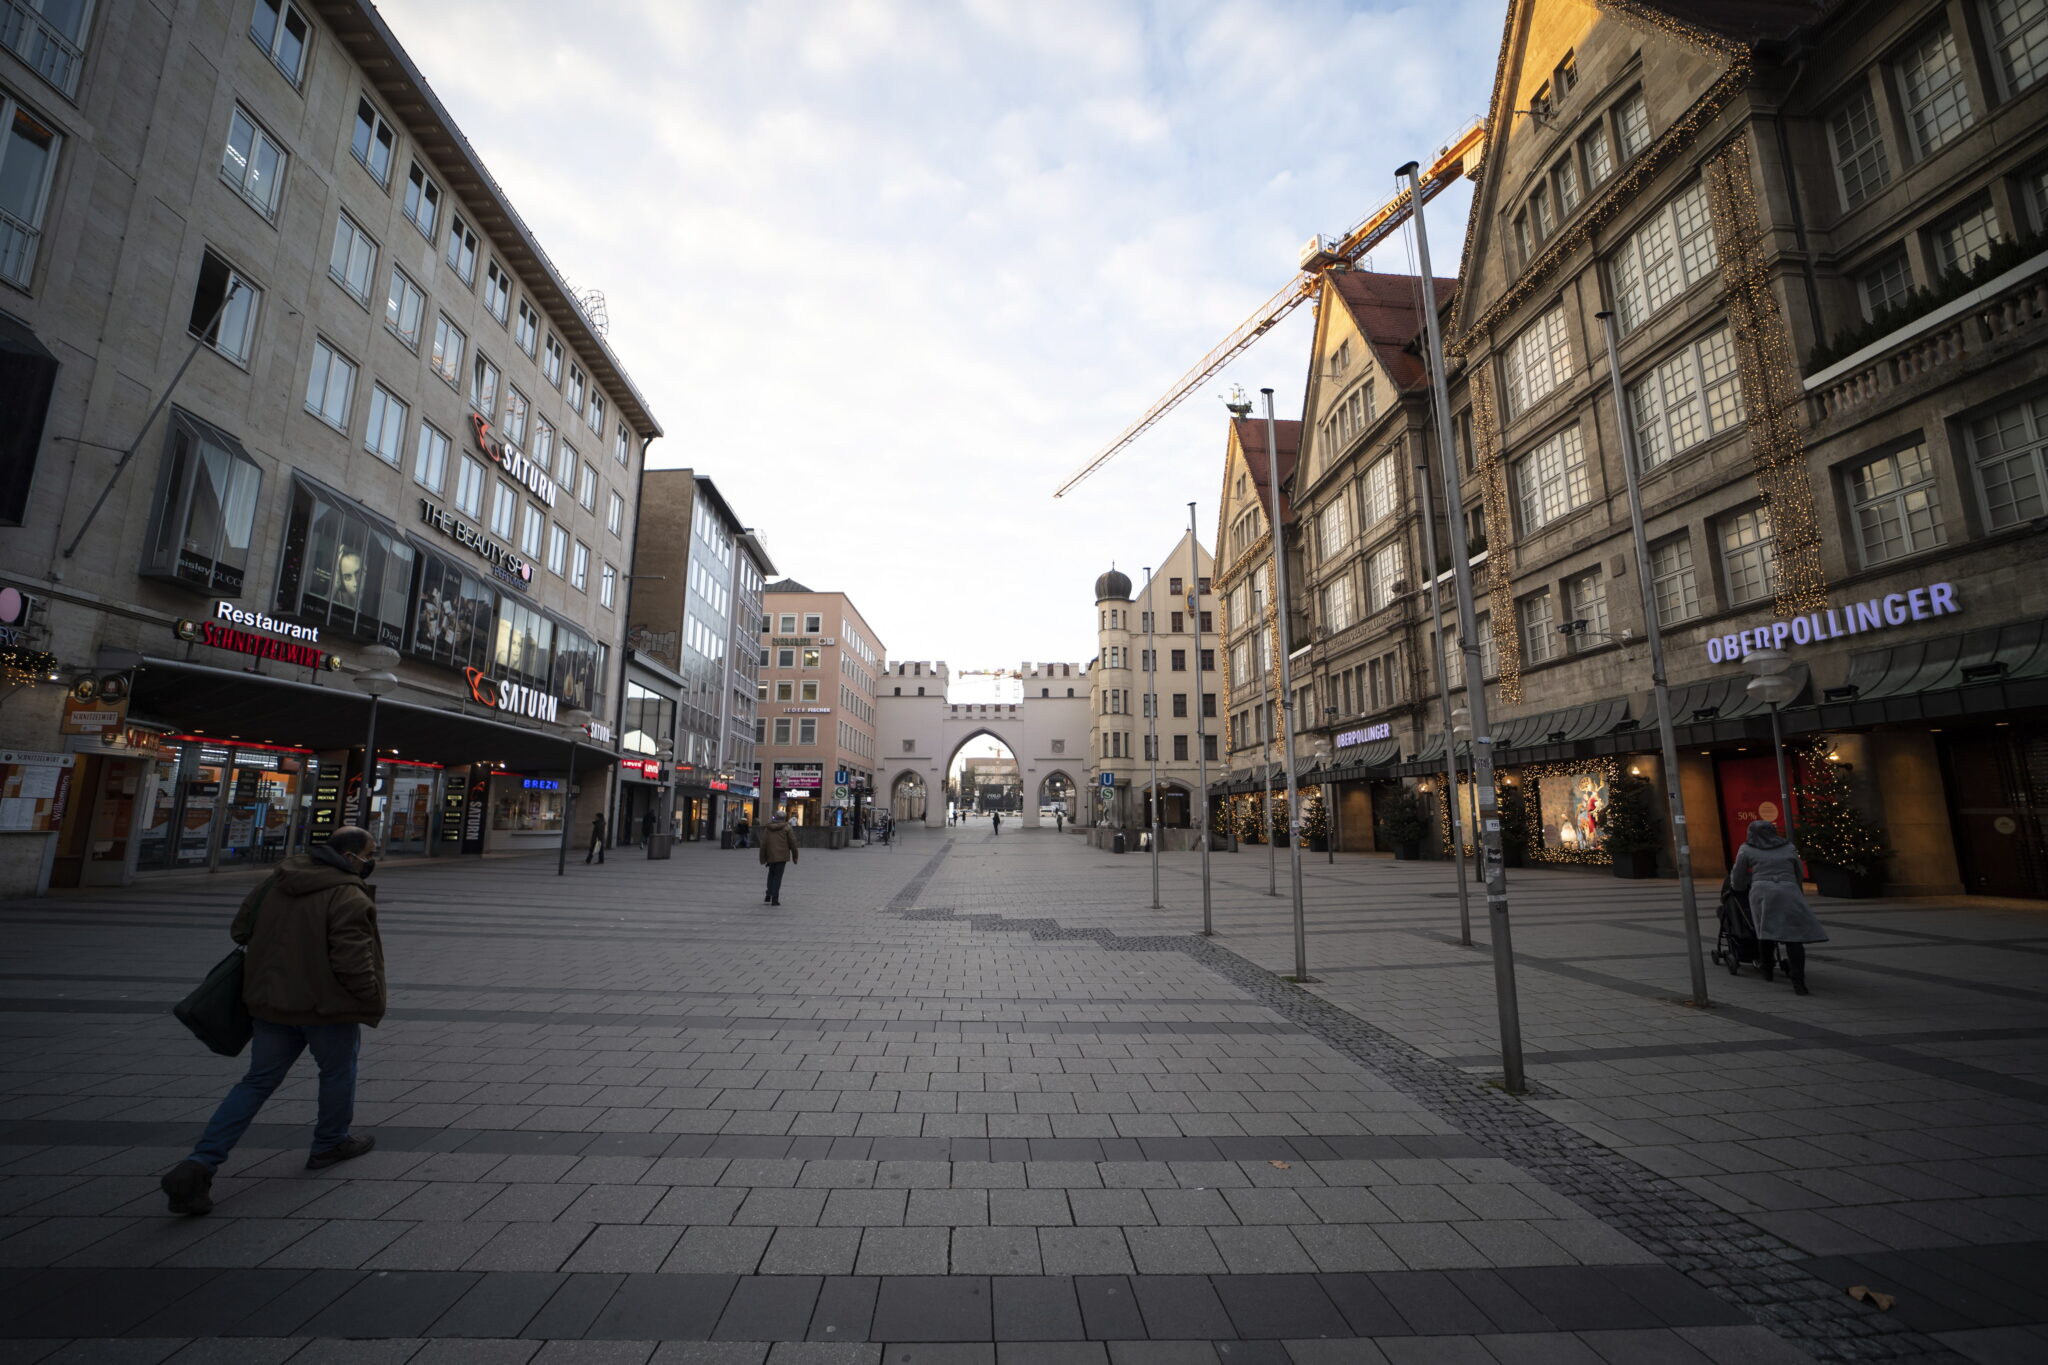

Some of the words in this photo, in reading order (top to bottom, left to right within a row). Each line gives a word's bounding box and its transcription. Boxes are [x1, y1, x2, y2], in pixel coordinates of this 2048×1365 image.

[502, 443, 557, 509] SATURN
[423, 499, 453, 533] THE
[456, 521, 505, 562] BEAUTY
[508, 554, 536, 583] SPOT
[218, 600, 319, 643] Restaurant
[382, 627, 400, 642] Dior
[1706, 581, 1961, 664] OBERPOLLINGER
[202, 621, 324, 669] SCHNITZELWIRT
[498, 679, 558, 723] SATURN
[590, 721, 610, 743] SATURN
[1336, 722, 1391, 748] OBERPOLLINGER
[523, 779, 559, 790] BREZN
[837, 772, 846, 783] U
[1103, 774, 1112, 785] U
[51, 775, 70, 821] Willkommen
[837, 788, 846, 797] S
[1103, 789, 1113, 799] S
[466, 801, 482, 840] SATURN
[1737, 811, 1748, 821] 50
